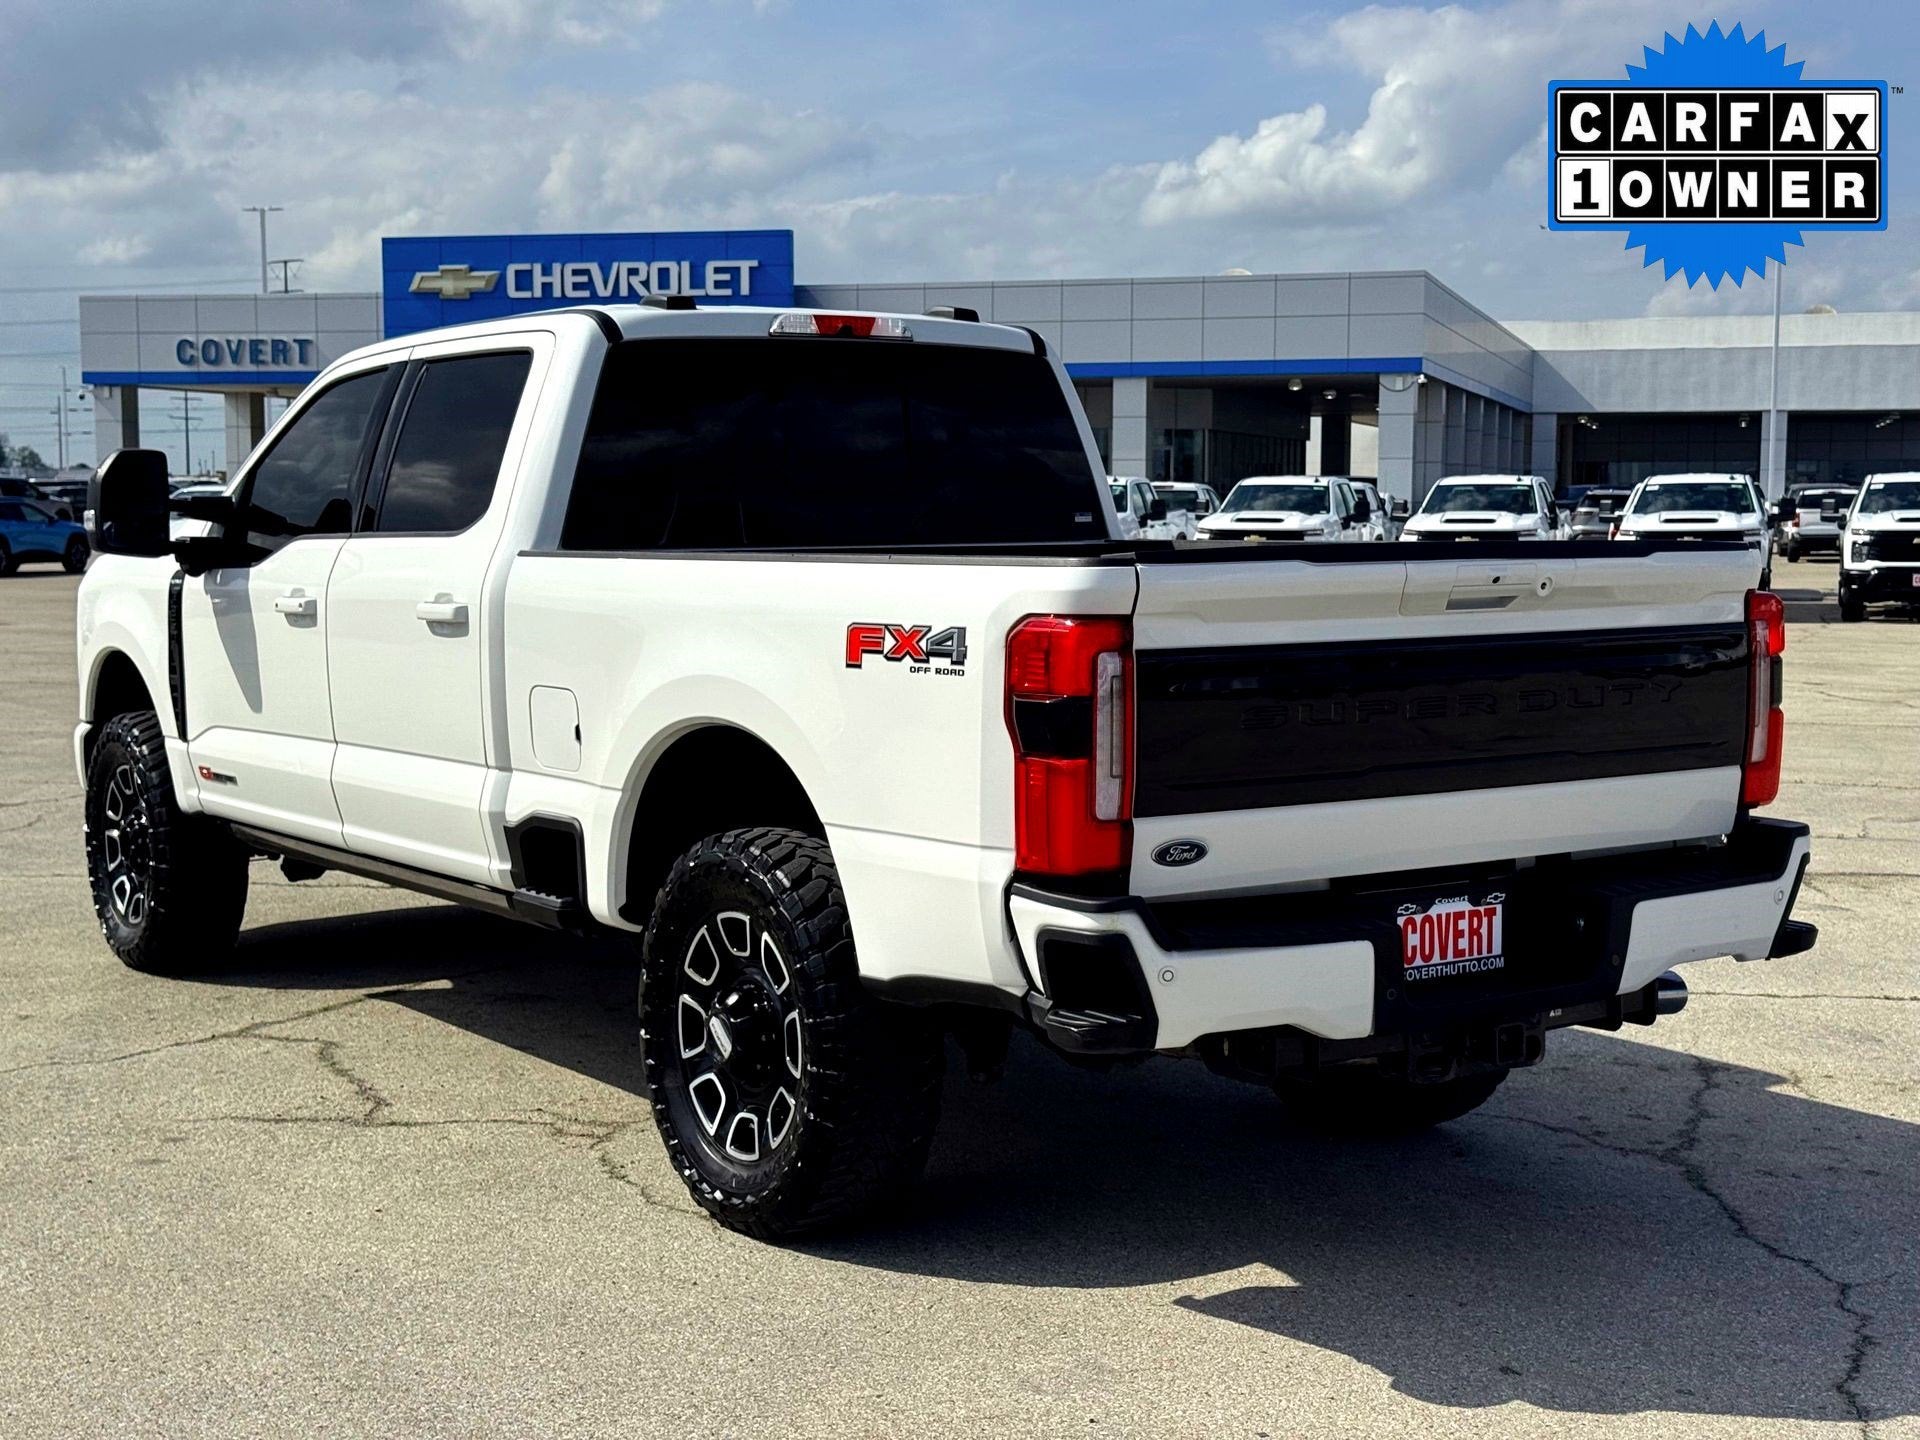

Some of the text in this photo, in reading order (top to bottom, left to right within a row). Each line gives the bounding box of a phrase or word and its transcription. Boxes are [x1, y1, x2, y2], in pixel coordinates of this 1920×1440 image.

[506, 260, 759, 298] CHEVROLET
[176, 338, 314, 366] COVERT
[846, 622, 968, 669] FX4
[909, 665, 965, 677] OFF ROAD
[1240, 680, 1683, 730] SUPER DUTY
[1166, 845, 1198, 861] Ford
[1435, 895, 1469, 905] Covert
[1402, 906, 1497, 967] COVERT
[1404, 956, 1505, 981] OVERTHUTTO.COM
